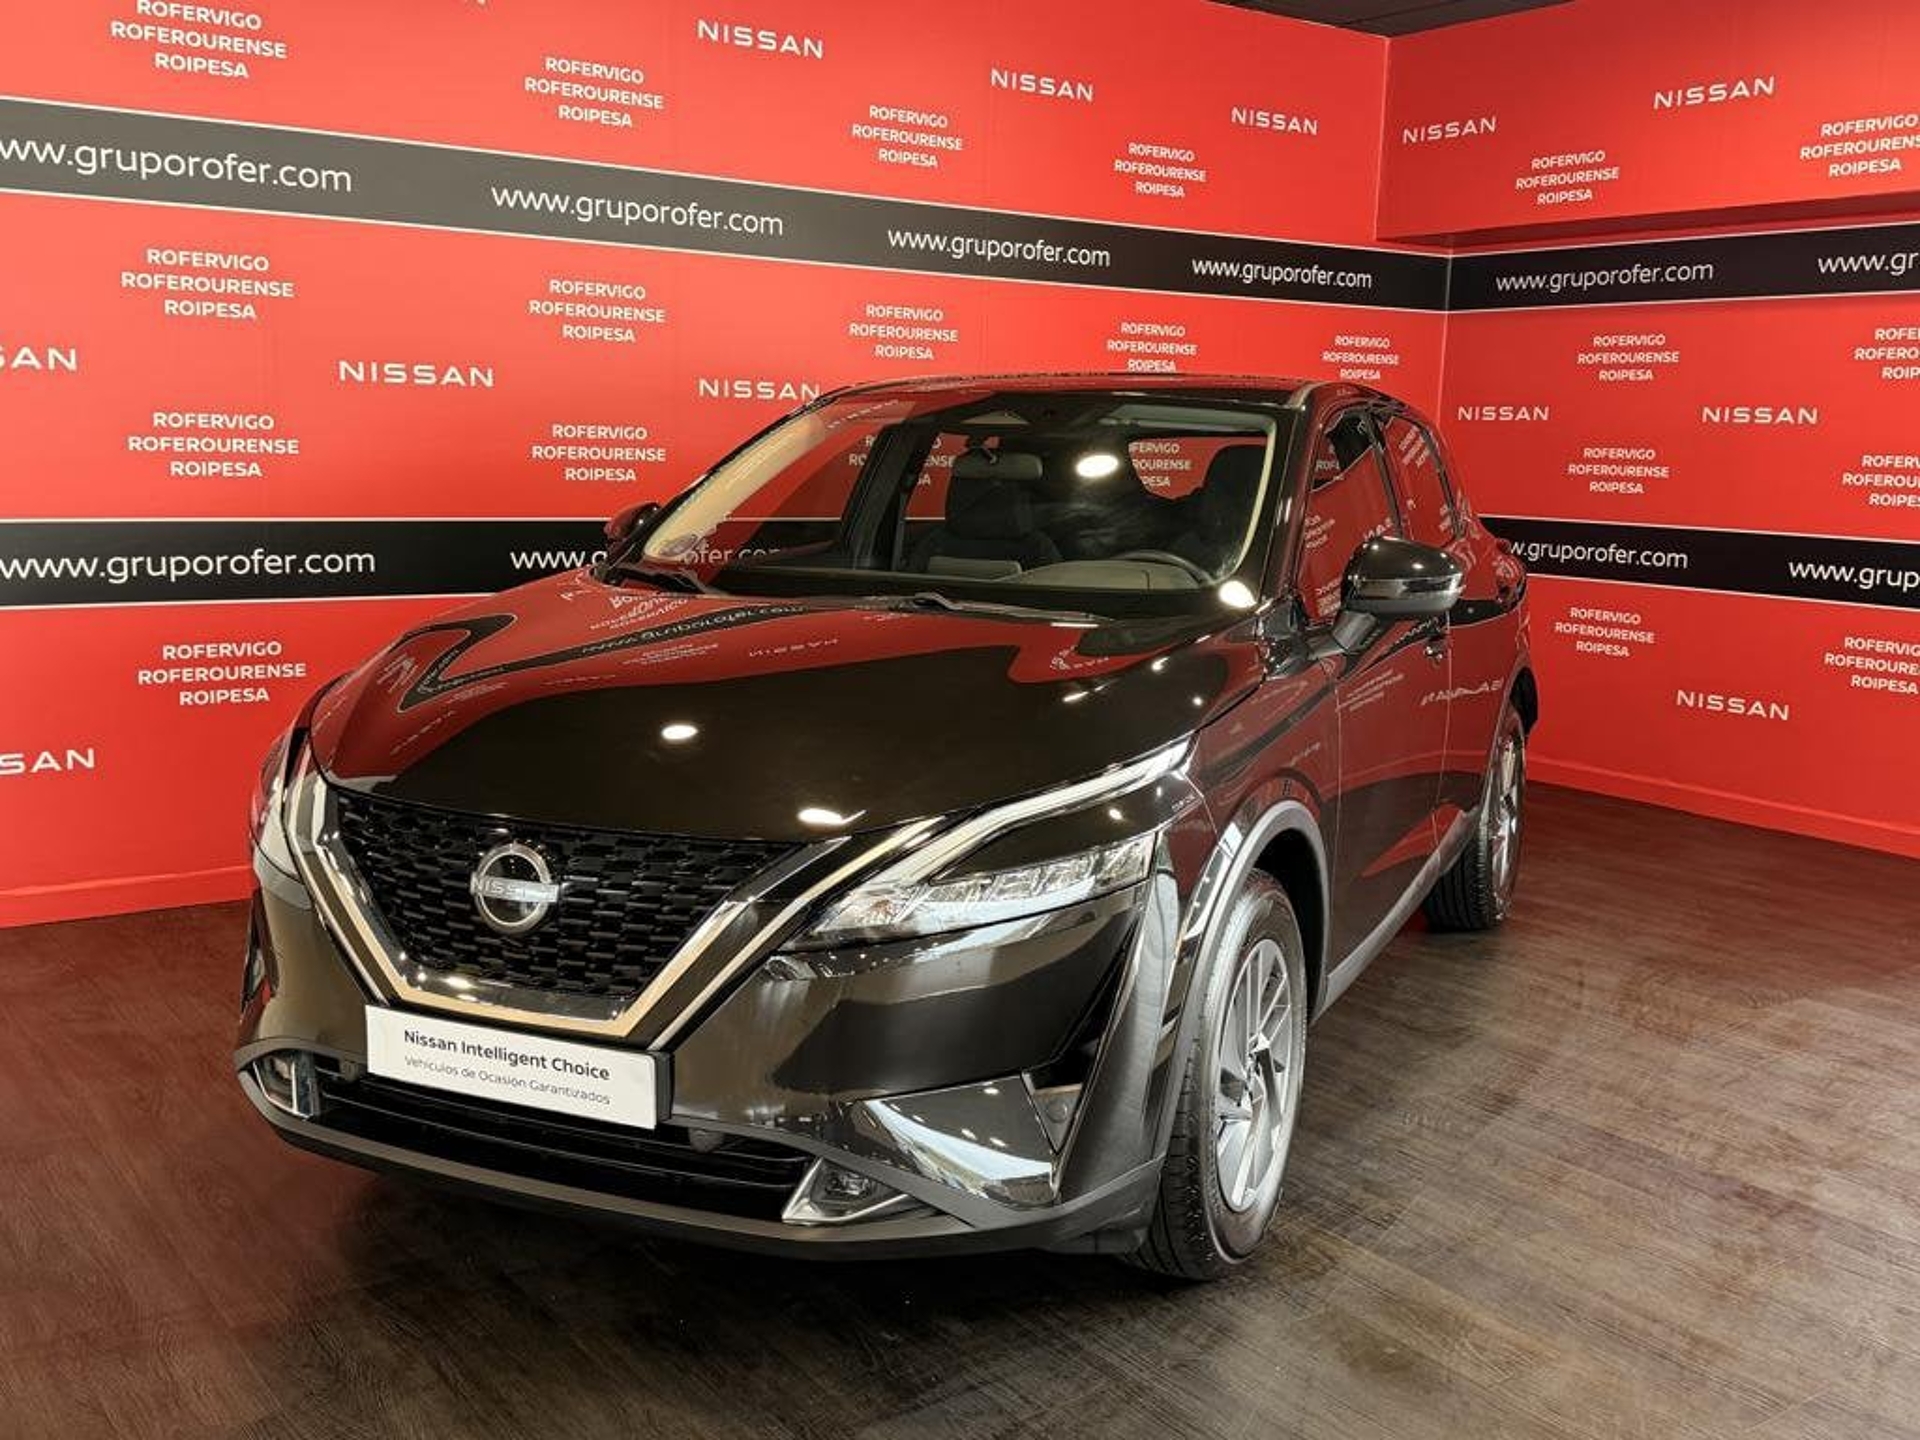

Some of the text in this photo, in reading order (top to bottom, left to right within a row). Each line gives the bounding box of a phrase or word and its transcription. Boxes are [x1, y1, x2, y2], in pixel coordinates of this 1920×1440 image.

[137, 0, 261, 30] ROFERVIGO
[111, 21, 286, 58] ROFEROURENSE
[698, 20, 822, 58] NISSAN
[155, 52, 248, 78] ROIPESA
[546, 58, 644, 84] ROFERVIGO
[525, 77, 663, 109] ROFEROURENSE
[992, 69, 1092, 101] NISSAN
[1654, 77, 1774, 109] NISSAN
[559, 106, 632, 127] ROIPESA
[870, 105, 948, 128] ROFERVIGO
[1232, 107, 1317, 135] NISSAN
[1821, 114, 1919, 137] ROFERVIGO
[852, 124, 962, 150] ROFEROURENSE
[1403, 117, 1496, 143] NISSAN
[878, 148, 938, 168] ROIPESA
[1129, 142, 1194, 162] ROFERVIGO
[1531, 150, 1605, 170] ROFERVIGO
[1114, 159, 1206, 181] ROFEROURENSE
[1829, 158, 1901, 176] ROIPESA
[1516, 167, 1619, 189] ROFEROURENSE
[1135, 181, 1185, 197] ROIPESA
[1537, 189, 1592, 204] ROIPESA
[492, 187, 782, 235] www.gruporofer.com
[888, 230, 1110, 266] www.gruporofer.com
[147, 249, 269, 271] ROFERVIGO
[1192, 259, 1371, 288] www.gruporofer.com
[1496, 264, 1713, 293] www.gruporofer.com
[122, 272, 293, 297] ROFEROURENSE
[550, 279, 645, 300] ROFERVIGO
[165, 300, 256, 319] ROIPESA
[529, 300, 664, 322] ROFEROURENSE
[866, 305, 943, 322] ROFERVIGO
[563, 324, 635, 342] ROIPESA
[849, 324, 958, 341] ROFEROURENSE
[1121, 322, 1185, 337] ROFERVIGO
[1107, 340, 1197, 355] ROFEROURENSE
[1335, 336, 1390, 349] ROFERVIGO
[1593, 334, 1665, 347] ROFERVIGO
[875, 345, 934, 359] ROIPESA
[1322, 351, 1398, 365] ROFEROURENSE
[1577, 351, 1679, 364] ROFEROURENSE
[339, 361, 493, 387] NISSAN
[1127, 359, 1177, 373] ROIPESA
[1340, 369, 1380, 381] ROIPESA
[1599, 369, 1653, 381] ROIPESA
[699, 379, 819, 400] NISSAN
[153, 412, 274, 430] ROFERVIGO
[1458, 406, 1549, 420] NISSAN
[1703, 407, 1817, 424] NISSAN
[553, 424, 647, 440] ROFERVIGO
[128, 436, 299, 454] ROFEROURENSE
[532, 446, 665, 461] ROFEROURENSE
[1584, 448, 1655, 460] ROFERVIGO
[171, 461, 262, 476] ROIPESA
[565, 467, 636, 481] ROIPESA
[1568, 464, 1669, 478] ROFEROURENSE
[1590, 481, 1644, 493] ROIPESA
[1570, 607, 1641, 625] ROFERVIGO
[1555, 622, 1654, 643] ROFEROURENSE
[163, 641, 281, 660] ROFERVIGO
[1576, 641, 1629, 657] ROIPESA
[138, 663, 306, 684] ROFEROURENSE
[1851, 675, 1918, 694] ROIPESA
[180, 688, 269, 705] ROIPESA
[1677, 690, 1788, 720] NISSAN
[404, 1030, 610, 1080] Nissan Intelligent Choice
